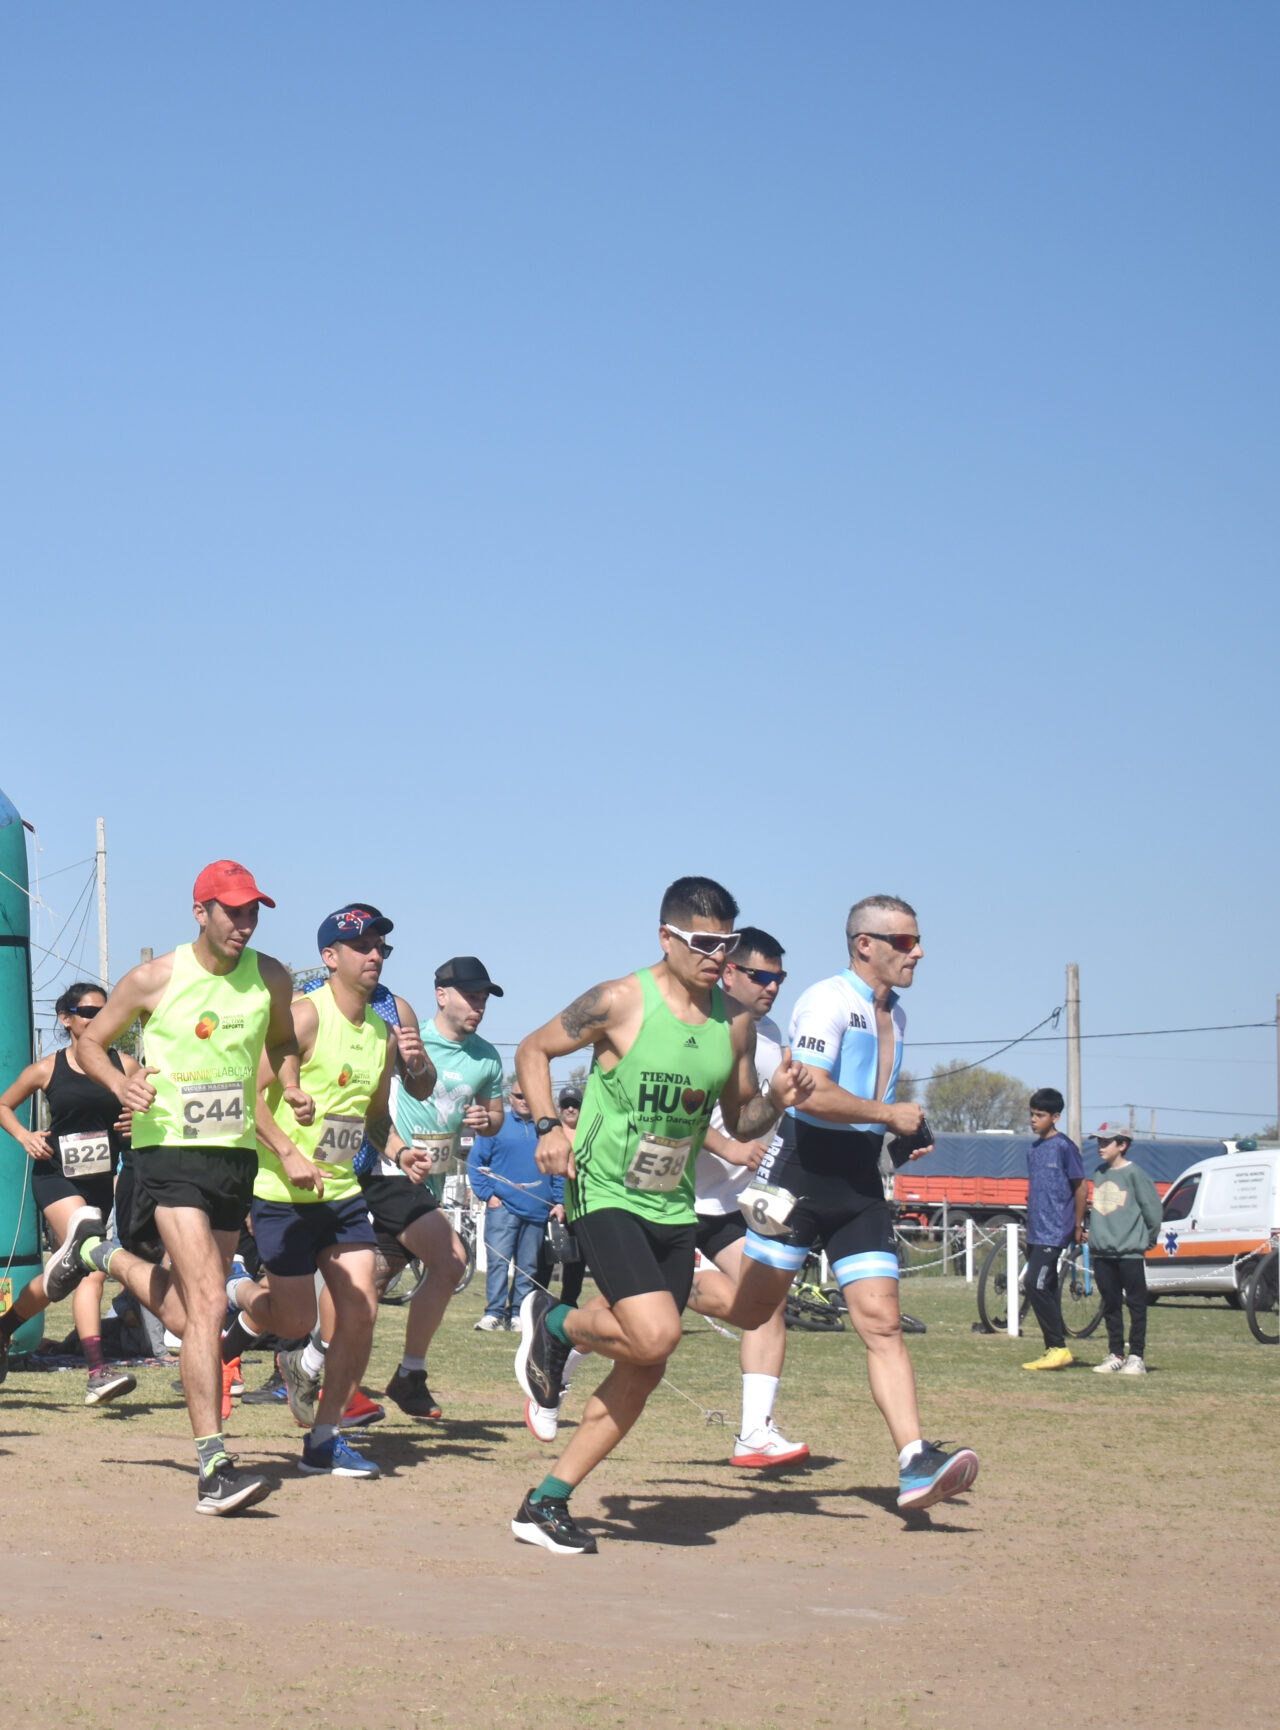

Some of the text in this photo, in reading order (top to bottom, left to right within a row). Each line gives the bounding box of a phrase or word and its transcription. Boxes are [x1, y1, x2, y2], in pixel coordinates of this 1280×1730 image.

[797, 1035, 826, 1053] ARG
[640, 1071, 692, 1086] TIENDA
[184, 1097, 243, 1124] C44
[318, 1127, 363, 1150] A06
[64, 1143, 110, 1165] B22
[633, 1151, 686, 1177] E38
[753, 1197, 769, 1225] 8
